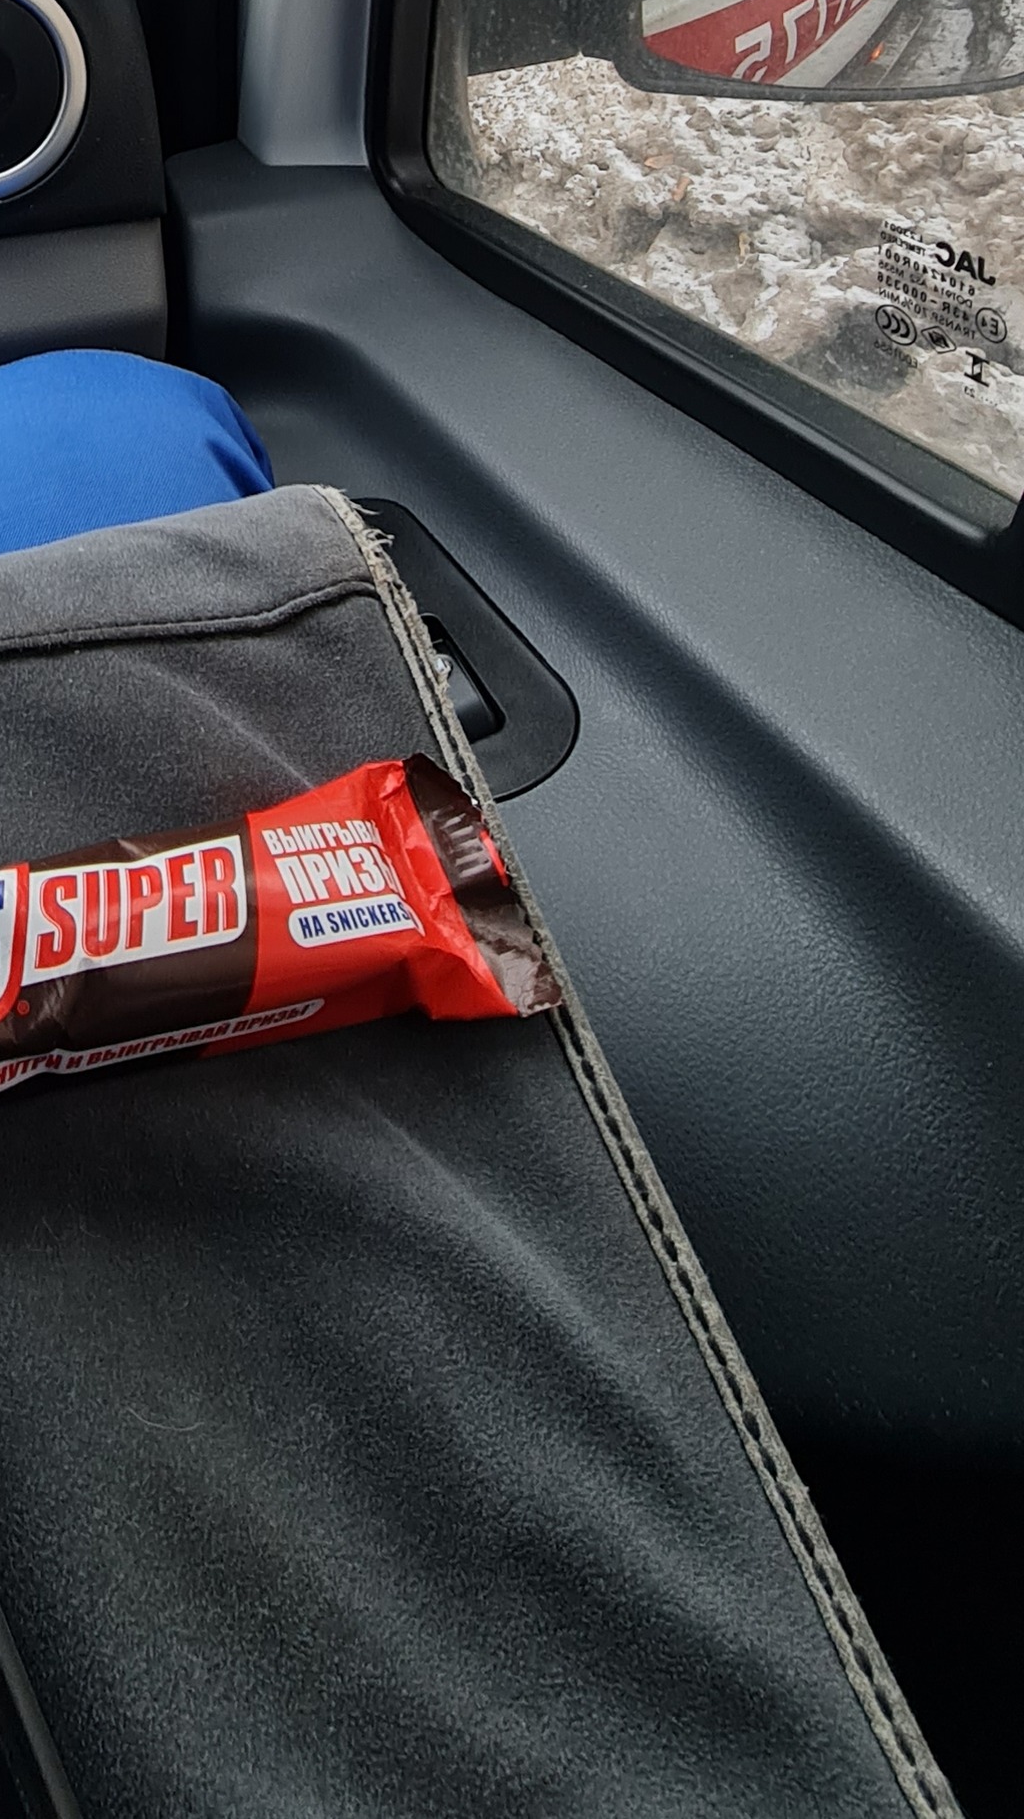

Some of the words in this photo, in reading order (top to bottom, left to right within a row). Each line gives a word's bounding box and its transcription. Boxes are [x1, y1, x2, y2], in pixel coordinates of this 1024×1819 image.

[33, 847, 240, 970] SUPER
[298, 914, 326, 939] НА
[329, 900, 411, 933] SNICKERS
[85, 1020, 230, 1066] ВЫИГРЫВАЙ
